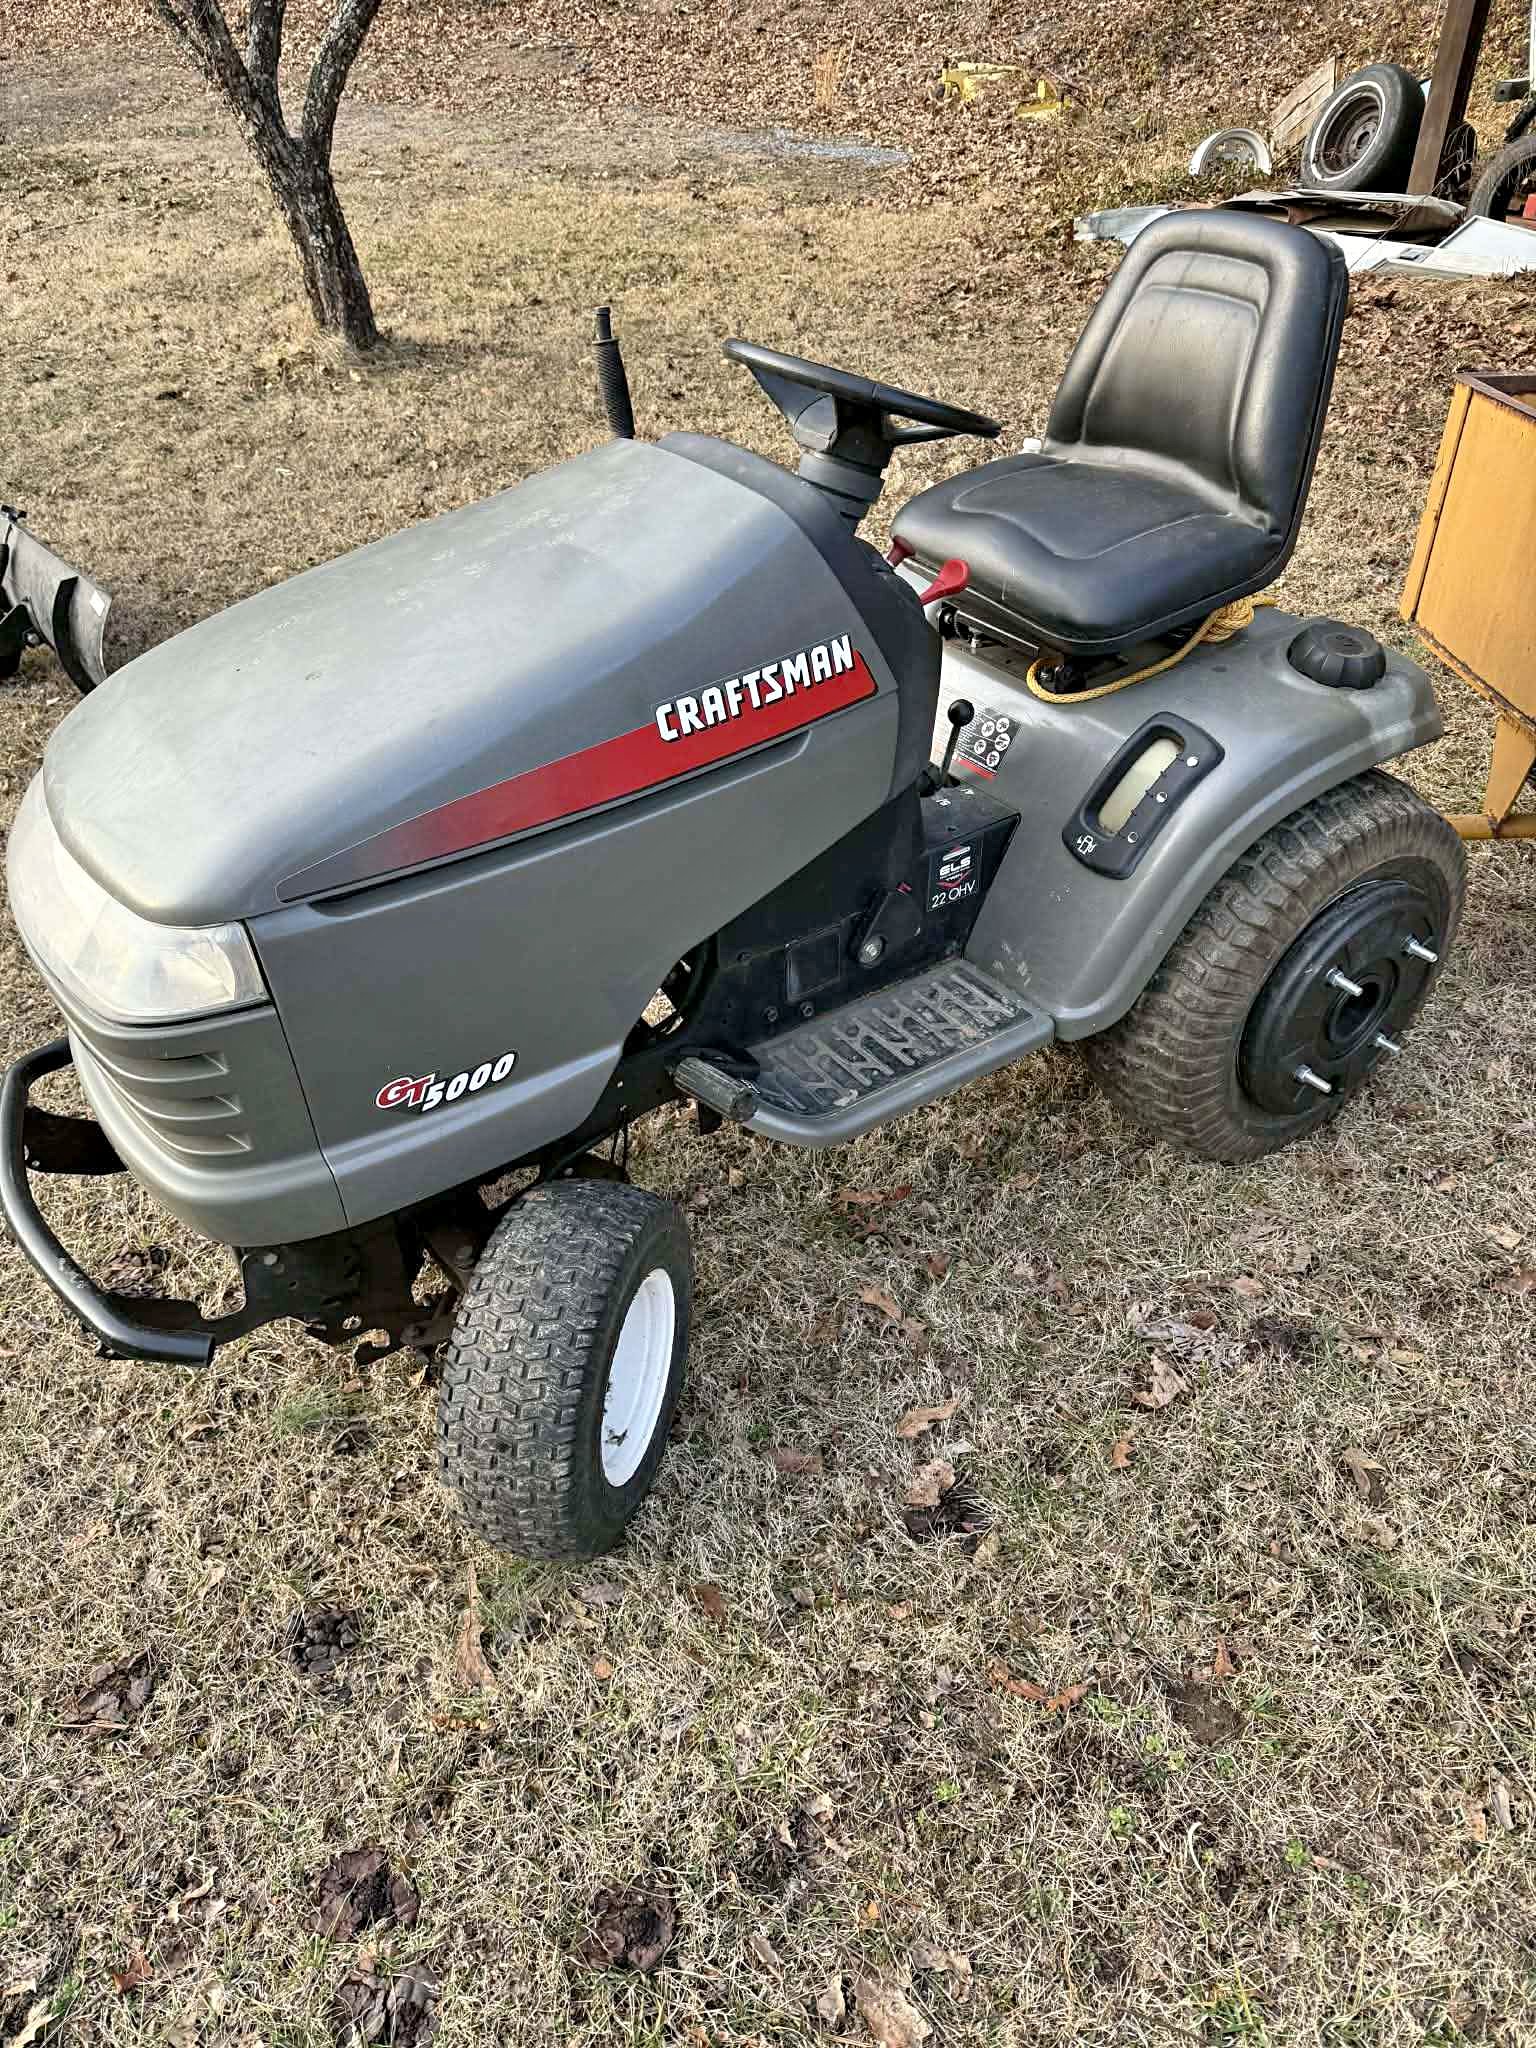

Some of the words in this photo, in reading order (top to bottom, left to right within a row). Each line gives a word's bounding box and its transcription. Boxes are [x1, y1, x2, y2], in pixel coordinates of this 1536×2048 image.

[655, 634, 854, 742] CRAFTSMAN
[939, 856, 971, 876] ELS
[931, 892, 947, 908] 22
[948, 880, 976, 900] OHV
